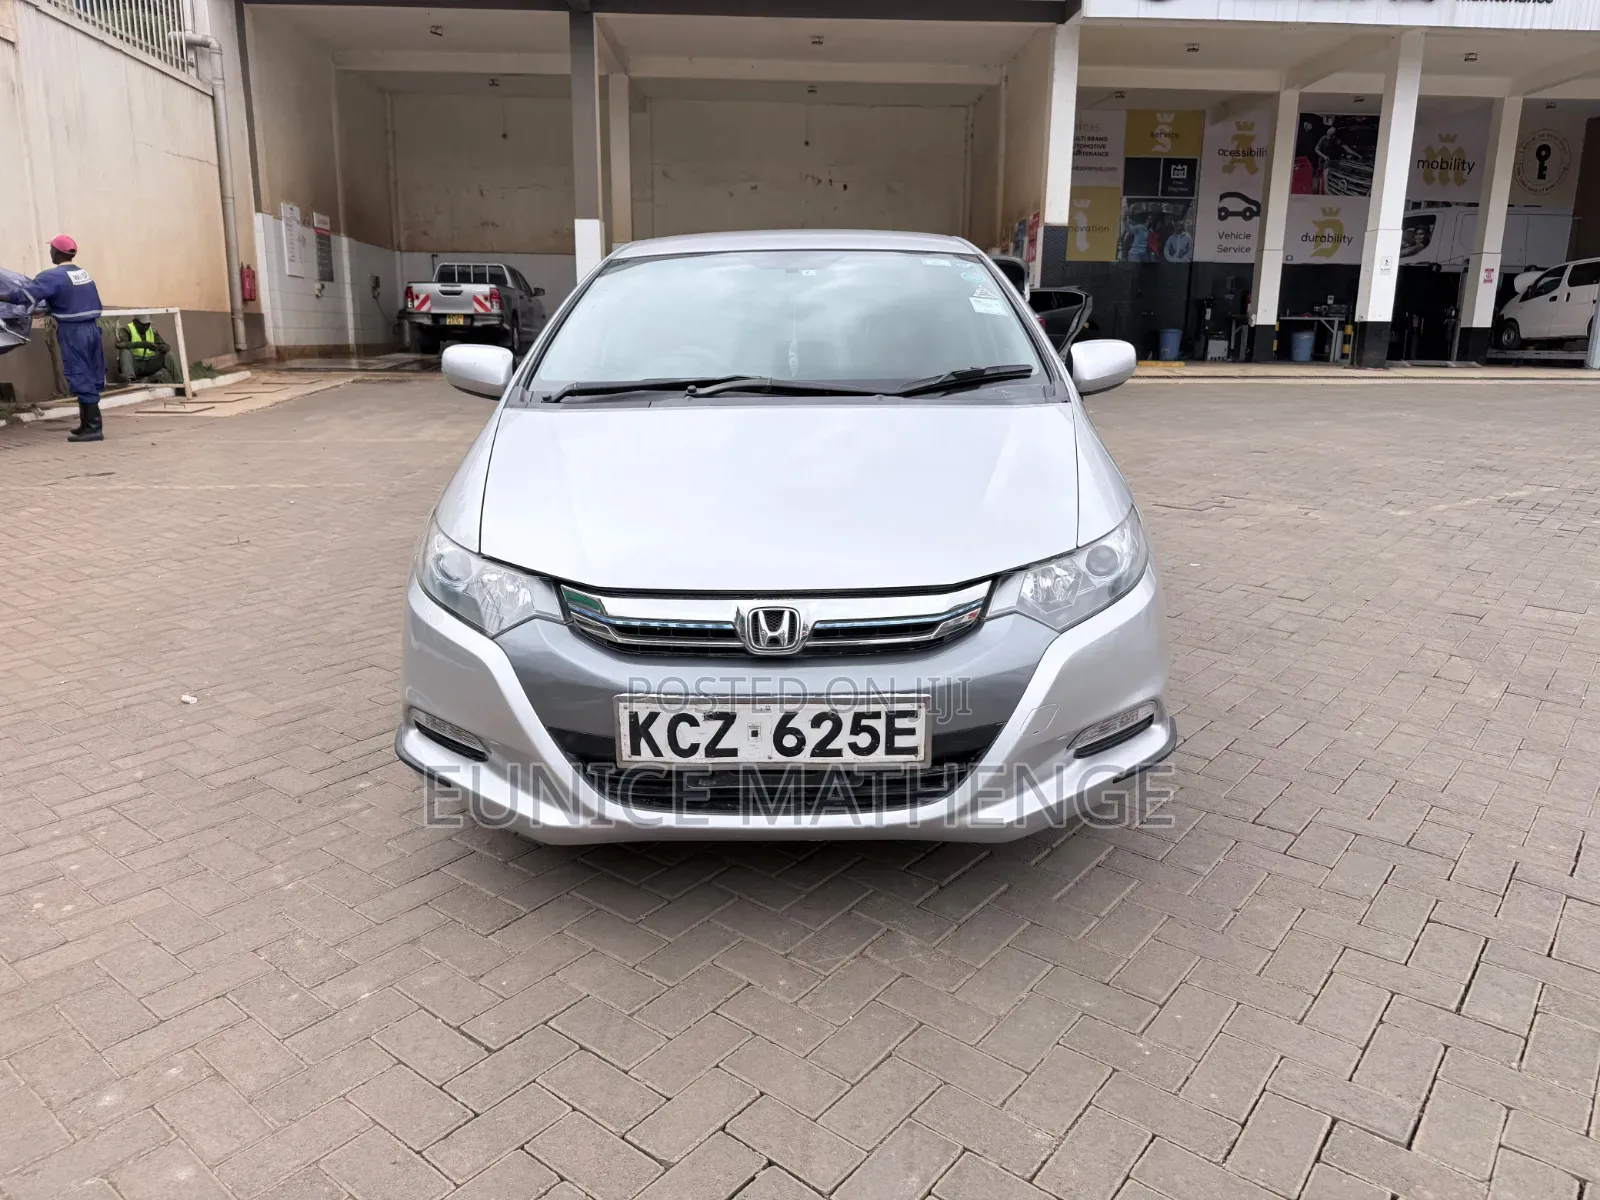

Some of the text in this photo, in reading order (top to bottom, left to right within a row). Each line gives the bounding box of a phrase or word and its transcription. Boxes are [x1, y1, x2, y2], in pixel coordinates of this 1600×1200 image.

[1150, 131, 1180, 139] service
[1417, 157, 1475, 175] mobility
[1218, 232, 1252, 240] Vehicle
[1301, 232, 1353, 246] durability
[1217, 245, 1252, 254] Service
[628, 711, 739, 758] KCZ
[772, 710, 920, 757] 625E
